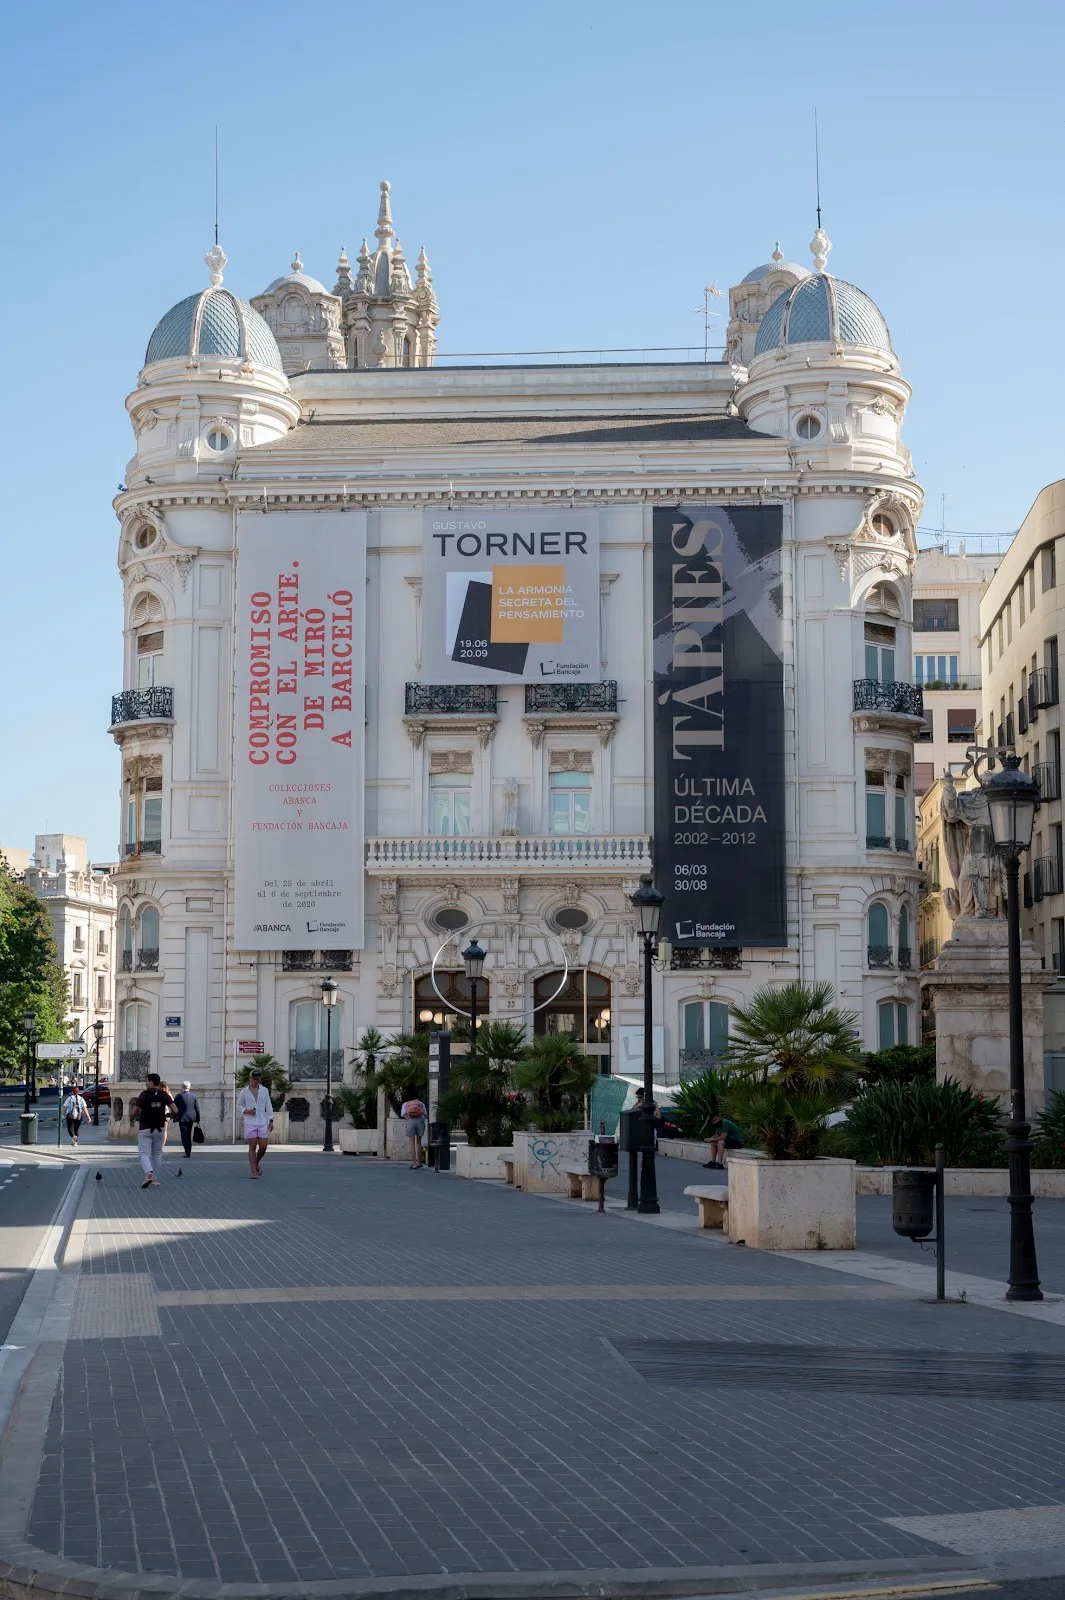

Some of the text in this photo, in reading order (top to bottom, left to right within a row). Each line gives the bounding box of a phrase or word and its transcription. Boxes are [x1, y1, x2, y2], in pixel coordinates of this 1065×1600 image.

[433, 521, 486, 530] GUSTAVO
[433, 531, 588, 557] TORNER
[498, 584, 573, 595] LA ARMONÍA
[498, 597, 579, 608] SECRETA DEL
[498, 609, 585, 620] PENSAMIENTO
[459, 639, 488, 648] 19.06
[658, 520, 725, 761] TÀPIES
[460, 649, 488, 658] 20.09
[276, 560, 299, 765] CON EL ARTE.
[300, 608, 326, 731] DE MIRÓ
[327, 590, 353, 748] A BARCELÓ
[248, 591, 272, 765] COMPROMISO
[268, 783, 331, 792] COLECCIONES
[674, 773, 756, 797] ÚLTIMA
[282, 796, 317, 805] ABANCA
[296, 809, 303, 817] Y
[674, 800, 768, 824] DÉCADA
[252, 821, 349, 830] FUNDACIÓN BANCAJA
[674, 864, 708, 876] 06/03
[264, 880, 278, 888] Del
[311, 879, 335, 887] abril
[674, 879, 708, 891] 30/08
[257, 890, 266, 898] al
[271, 890, 276, 898] 6
[294, 889, 342, 899] septiembre
[282, 900, 316, 908] de 2026
[696, 922, 735, 931] Fundación
[696, 930, 726, 940] Bancaja
[507, 1000, 516, 1008] 23
